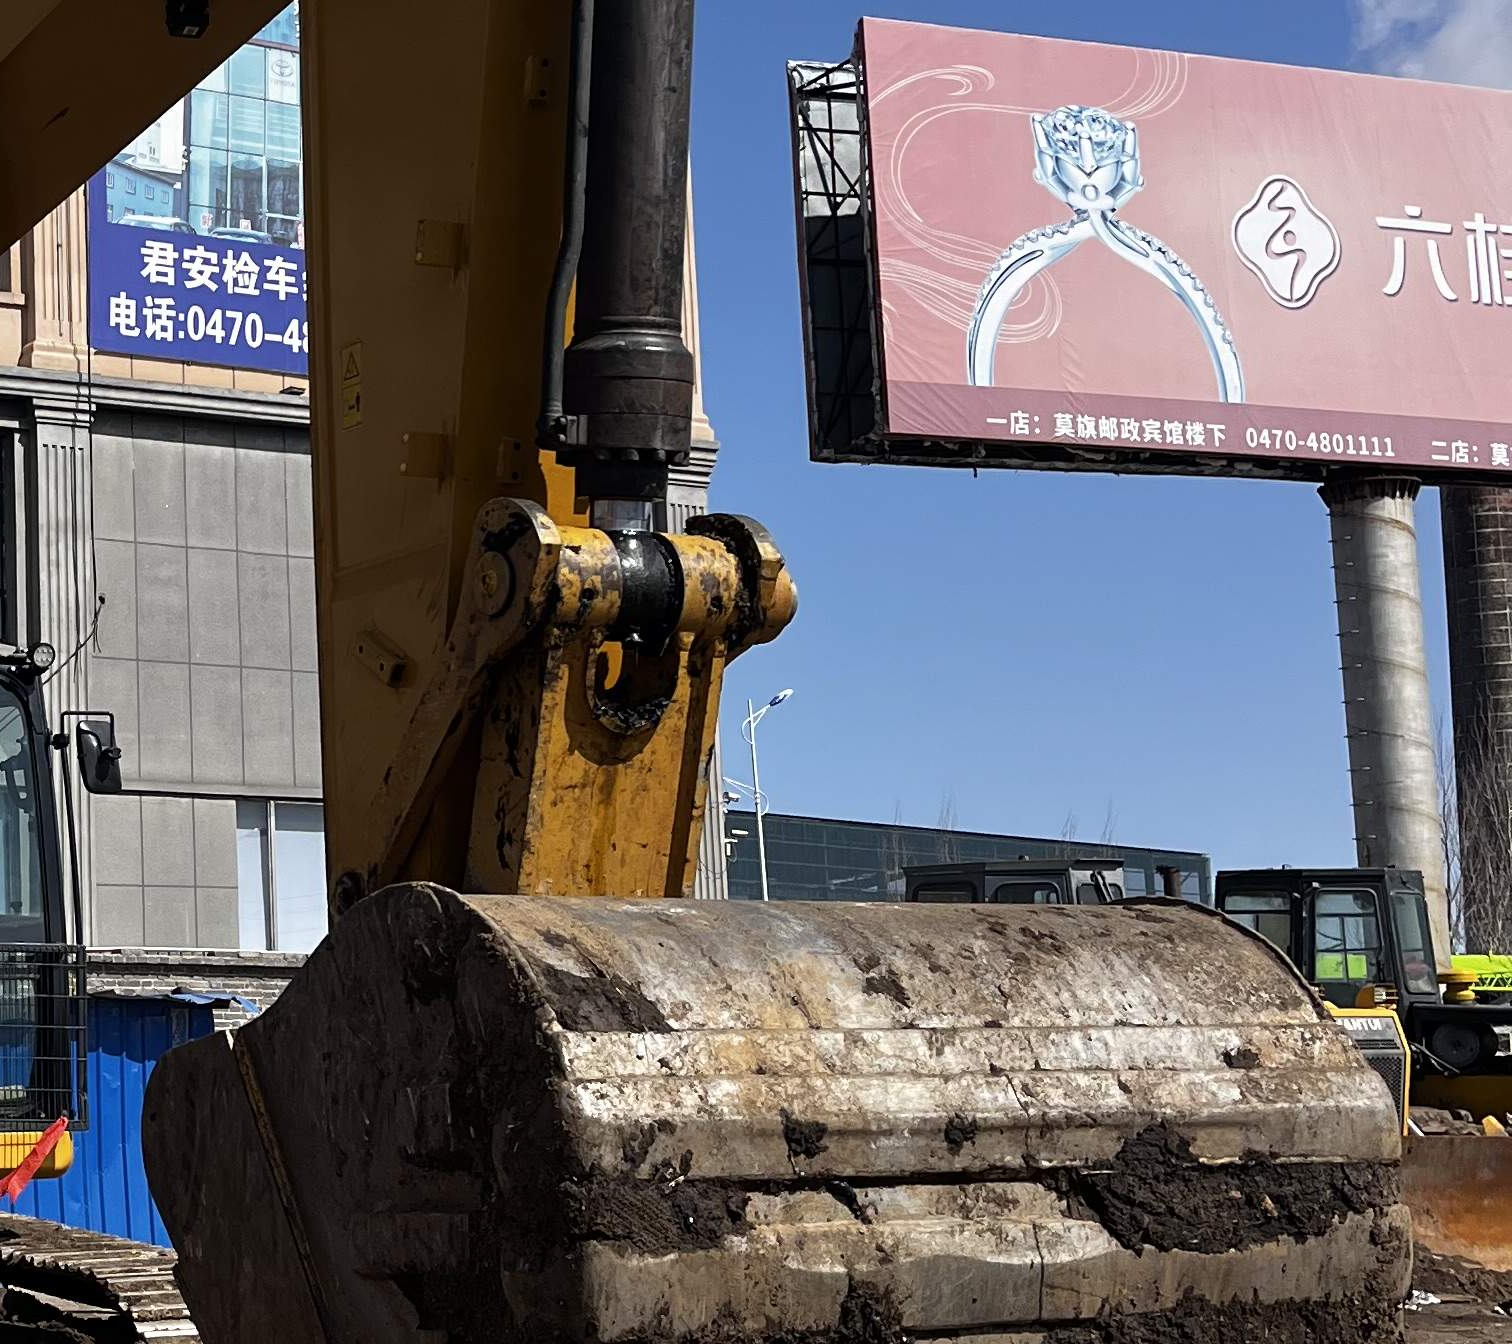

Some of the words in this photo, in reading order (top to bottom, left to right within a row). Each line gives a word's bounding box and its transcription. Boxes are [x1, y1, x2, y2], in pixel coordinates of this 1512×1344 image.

[140, 239, 308, 302] 君安检车
[1245, 427, 1395, 457] 0470-4801111
[1431, 439, 1512, 467] 二店：莫
